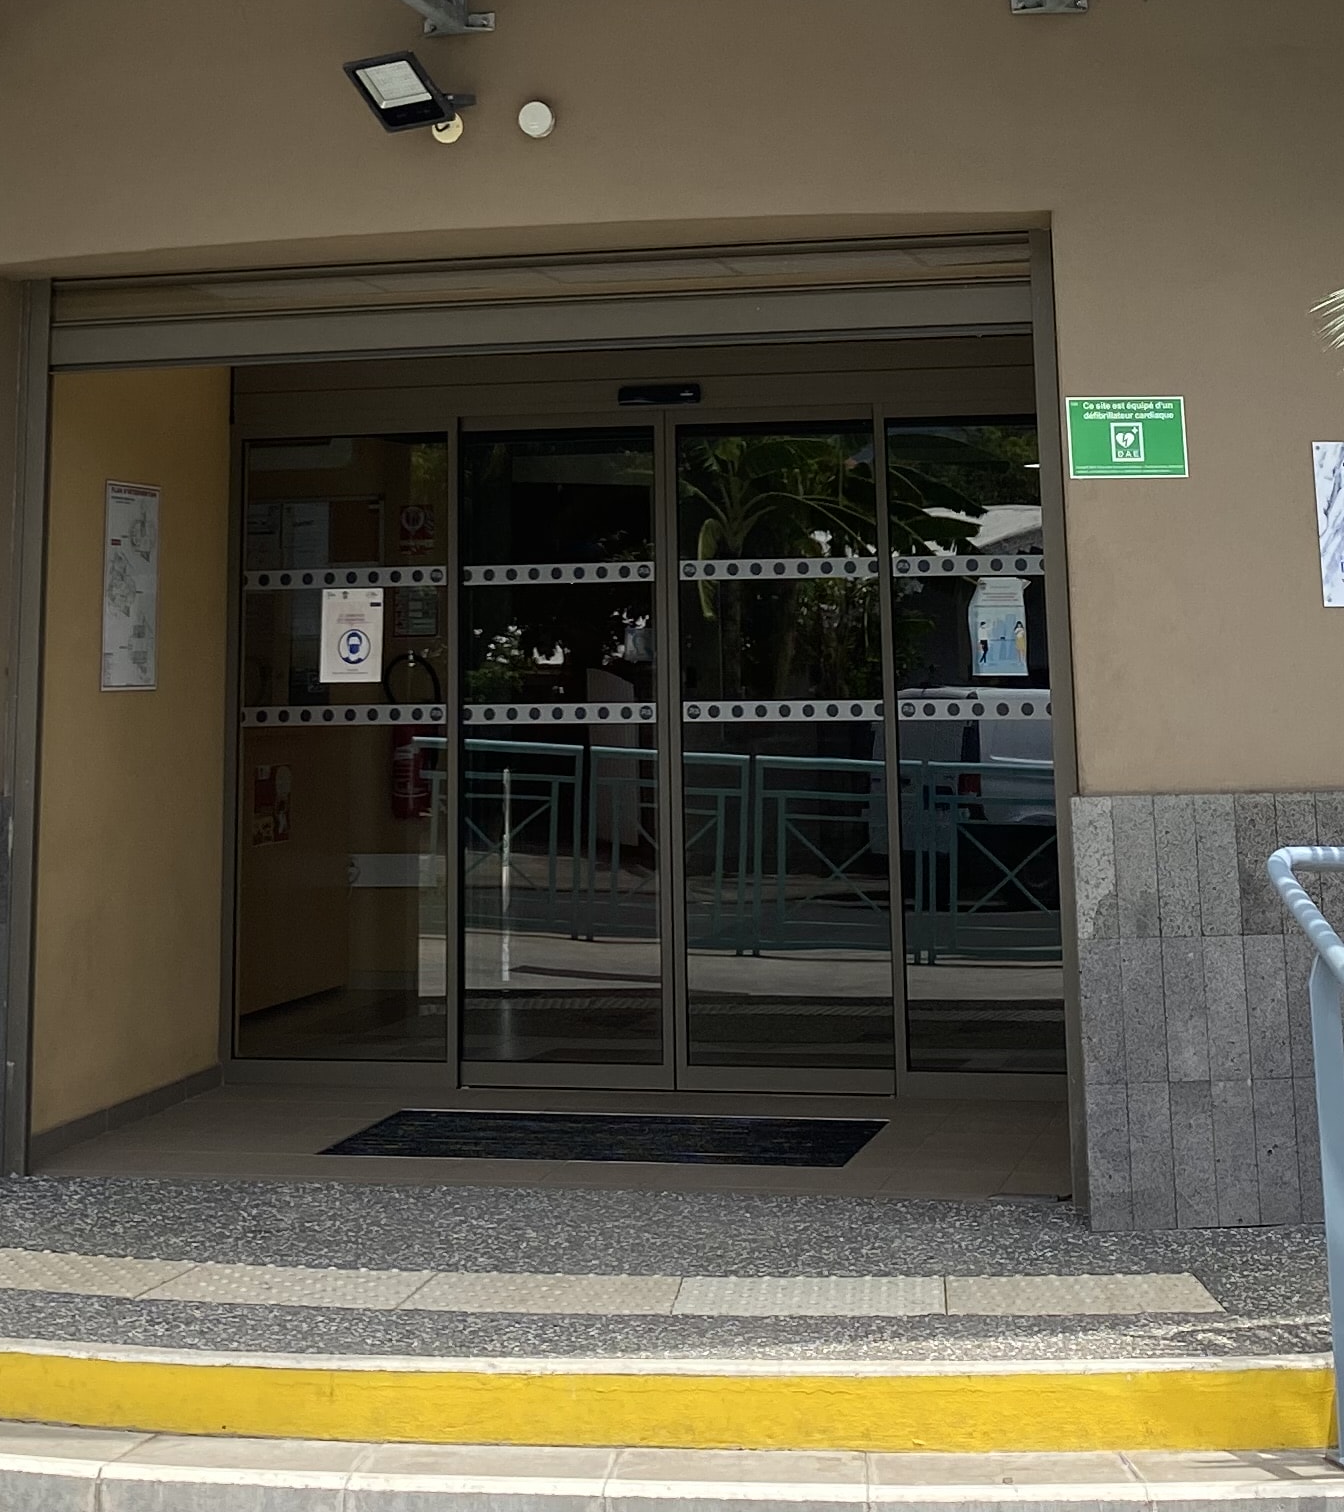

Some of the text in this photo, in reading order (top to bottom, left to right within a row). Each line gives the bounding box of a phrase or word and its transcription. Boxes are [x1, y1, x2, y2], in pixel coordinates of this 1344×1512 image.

[1126, 401, 1154, 411] équipé
[1155, 401, 1174, 409] d'un
[1083, 411, 1174, 420] défibrillateur cardiaque
